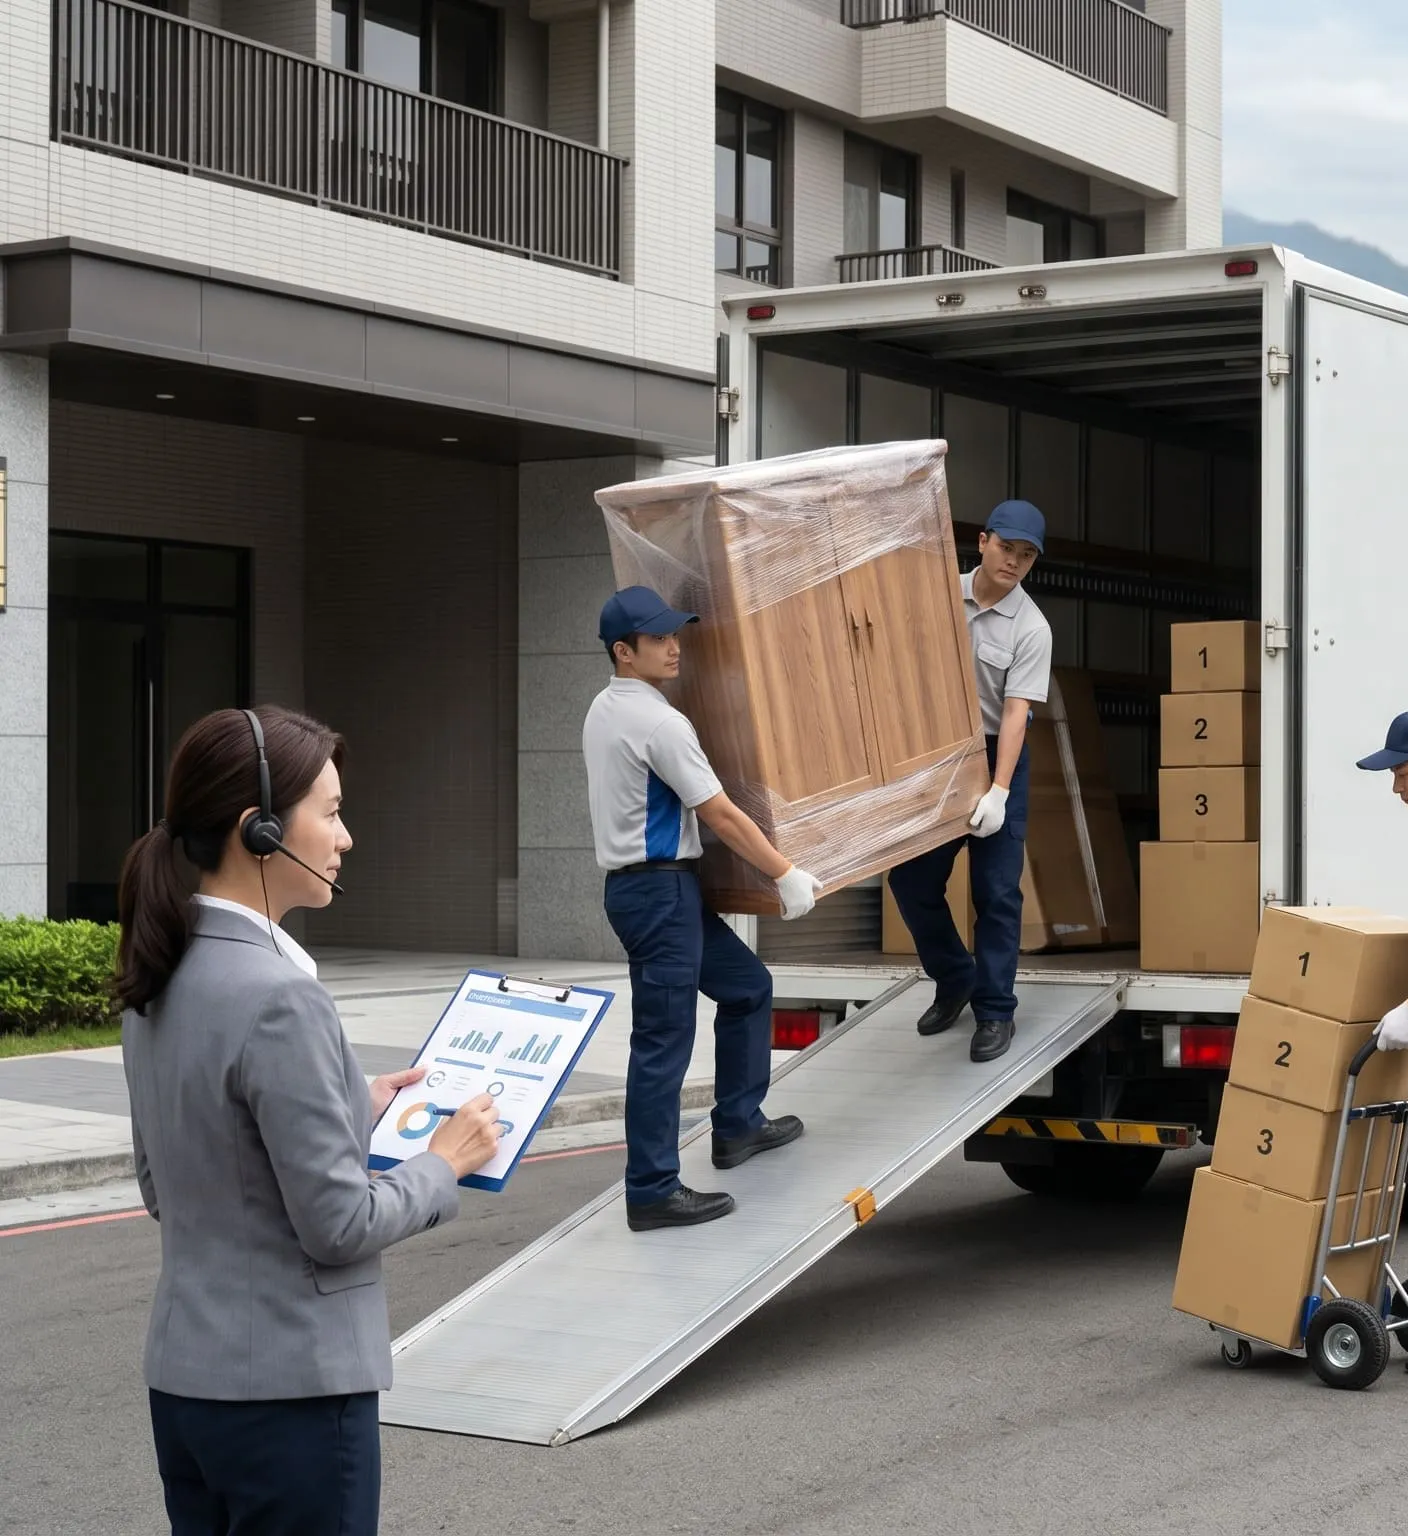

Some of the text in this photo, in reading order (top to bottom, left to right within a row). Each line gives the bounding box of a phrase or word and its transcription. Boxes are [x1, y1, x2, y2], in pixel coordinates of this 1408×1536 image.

[1198, 646, 1208, 669] 1
[1194, 718, 1208, 740] 2
[1195, 793, 1209, 816] 3
[1298, 951, 1310, 977] 1
[1274, 1041, 1292, 1068] 2
[1256, 1128, 1274, 1156] 3
